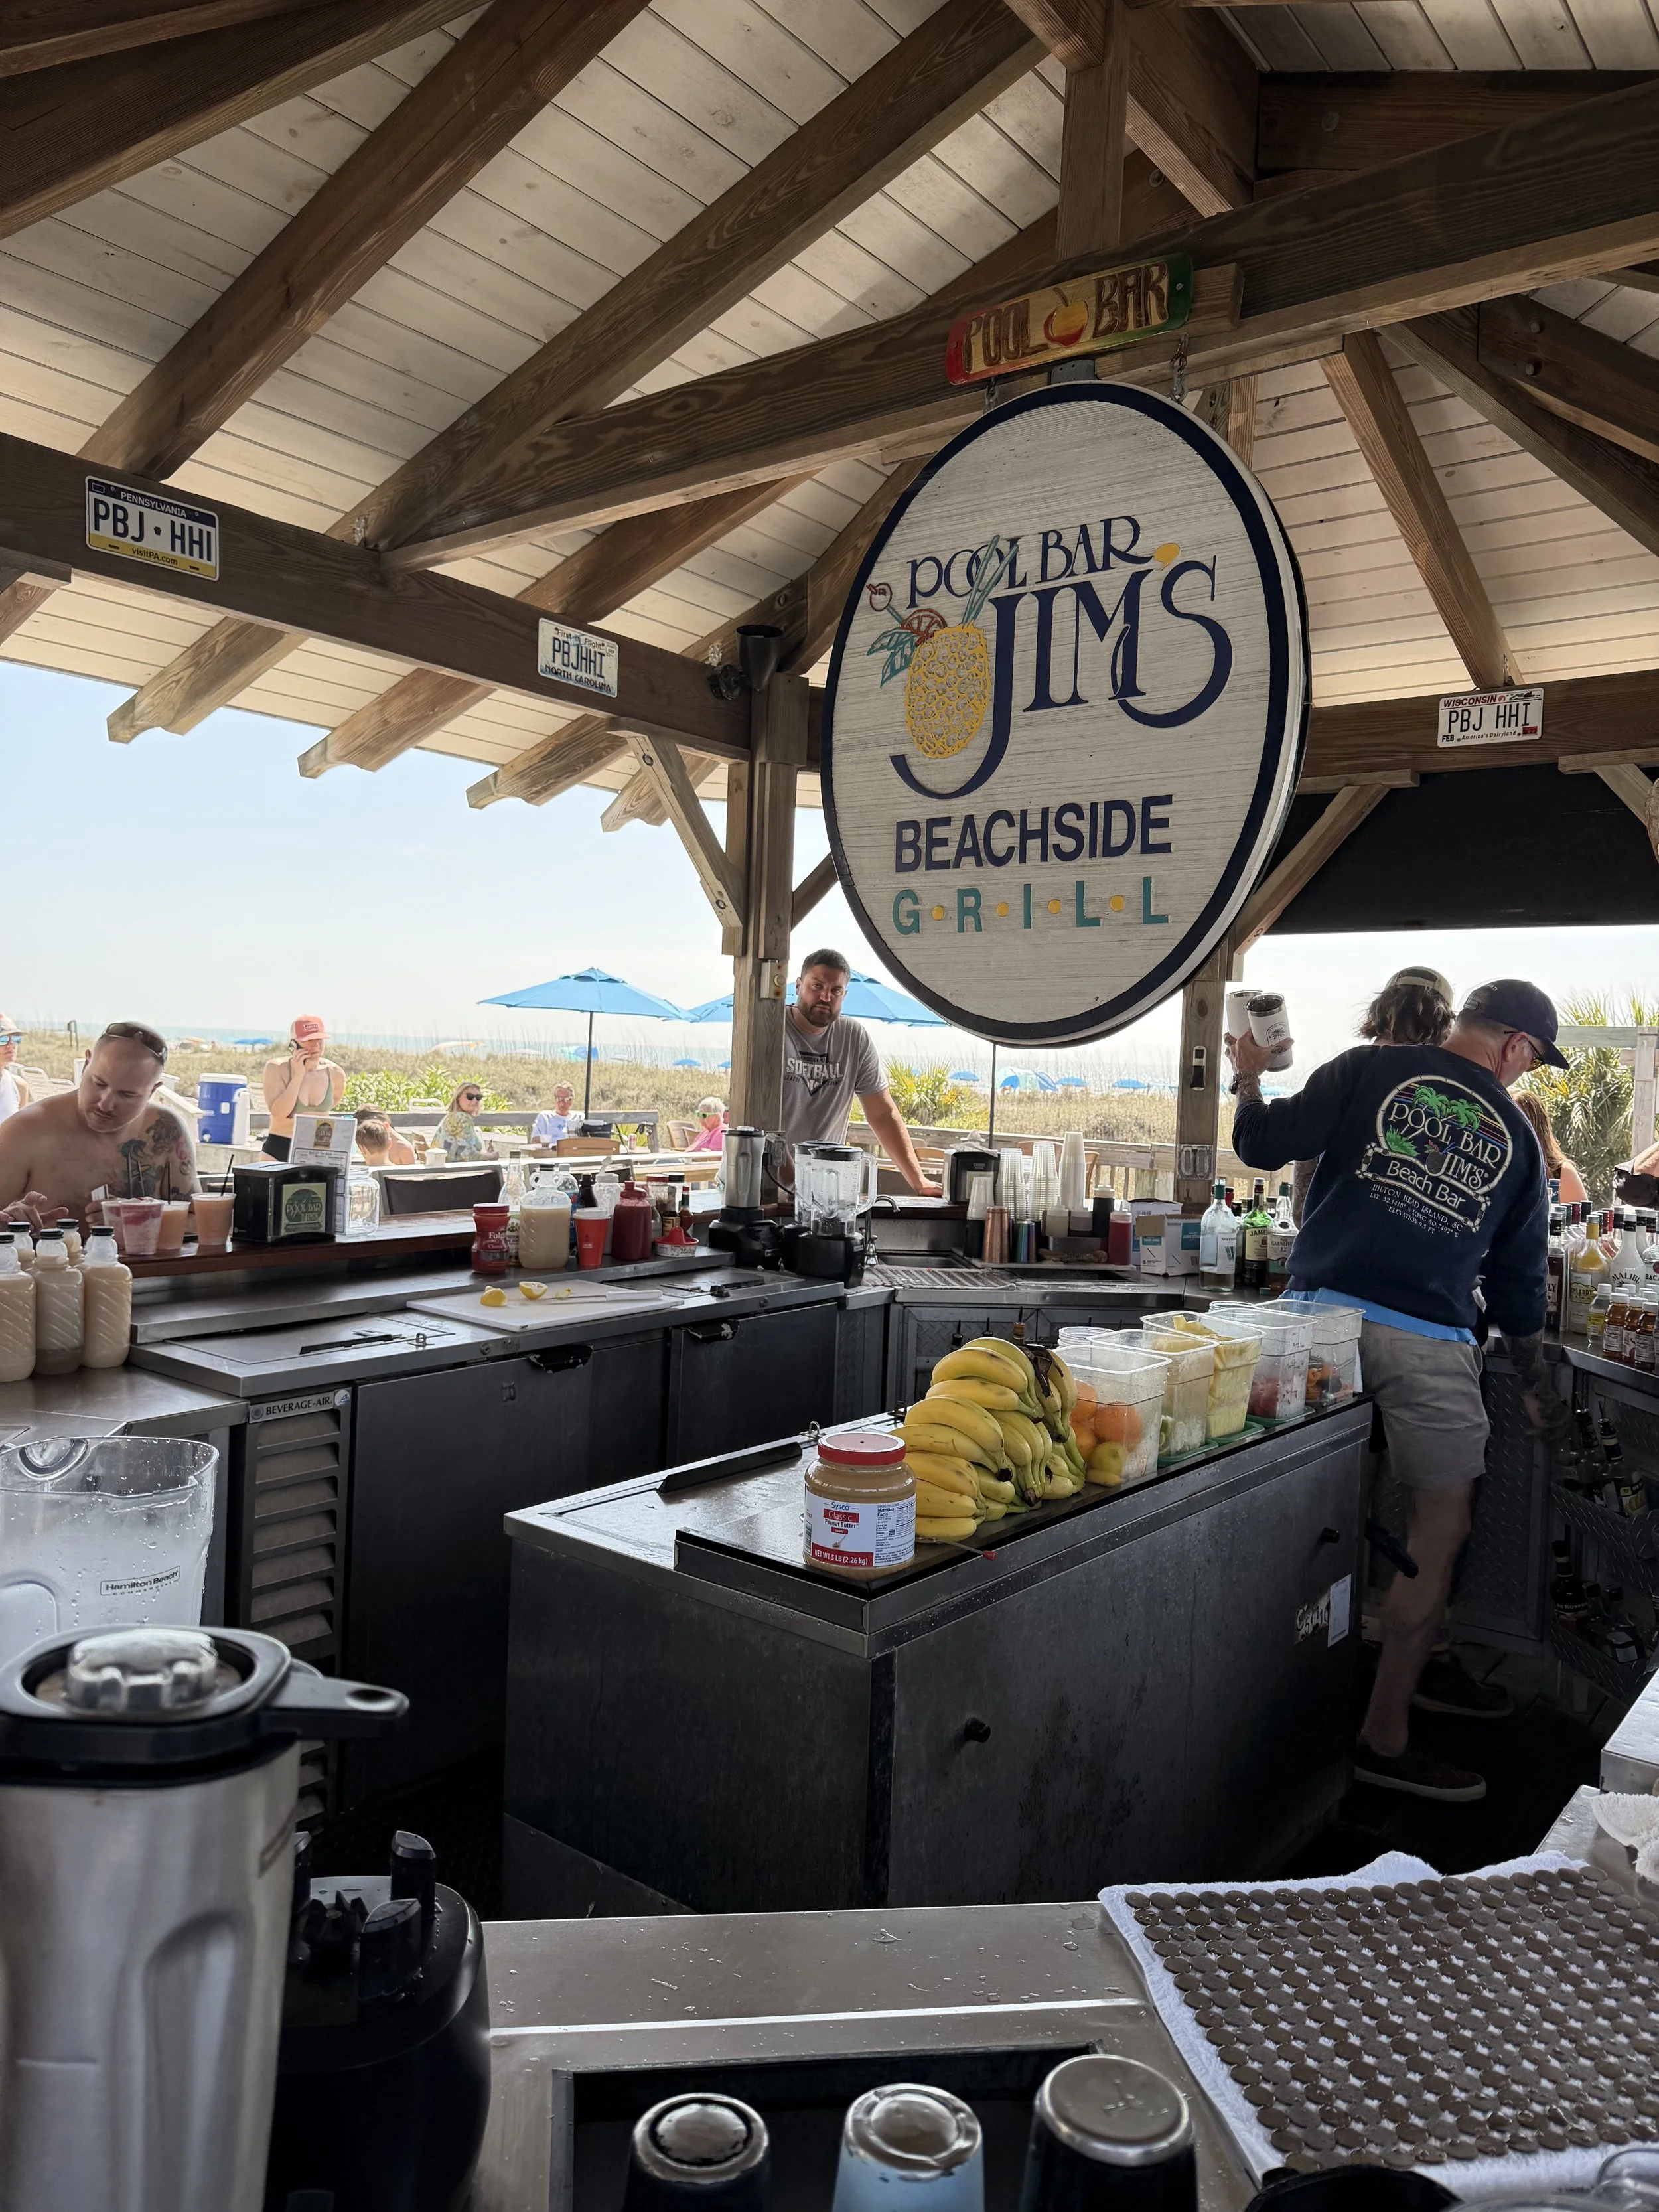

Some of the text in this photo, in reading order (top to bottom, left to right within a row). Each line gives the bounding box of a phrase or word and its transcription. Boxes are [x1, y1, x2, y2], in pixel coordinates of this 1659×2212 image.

[966, 261, 1169, 373] POOL BAR
[120, 491, 186, 518] PENNSYLVANIA
[94, 498, 212, 561] PBJ HHI
[131, 548, 178, 565] visitPA.com
[907, 516, 1155, 609] POOL BAR
[557, 629, 571, 639] First
[585, 638, 601, 650] Flight
[552, 636, 606, 679] PBJHHI
[545, 664, 611, 692] NORTH CAROLINA
[889, 543, 1233, 800] JIM'S
[1444, 695, 1497, 708] WISCONSIN
[1448, 703, 1530, 734] PBJ HHI
[1489, 730, 1517, 739] Dairyland
[895, 795, 1173, 873] BEACHSIDE
[786, 1057, 843, 1080] SOFTBALL
[1388, 1102, 1500, 1169] POOL BAR
[1387, 1160, 1466, 1209] Beach Bar
[1372, 1184, 1463, 1232] HILTON HEAD ISLAND, SC
[1388, 1206, 1417, 1224] ELEVATION
[488, 1231, 505, 1240] Folg
[1612, 1272, 1642, 1285] MALIBU
[265, 1396, 332, 1415] BEVERAGE-AIR
[828, 1511, 853, 1522] Classic
[831, 1501, 850, 1511] Sysco
[859, 1557, 868, 1566] kg)
[106, 1570, 177, 1591] Hamilton Beach
